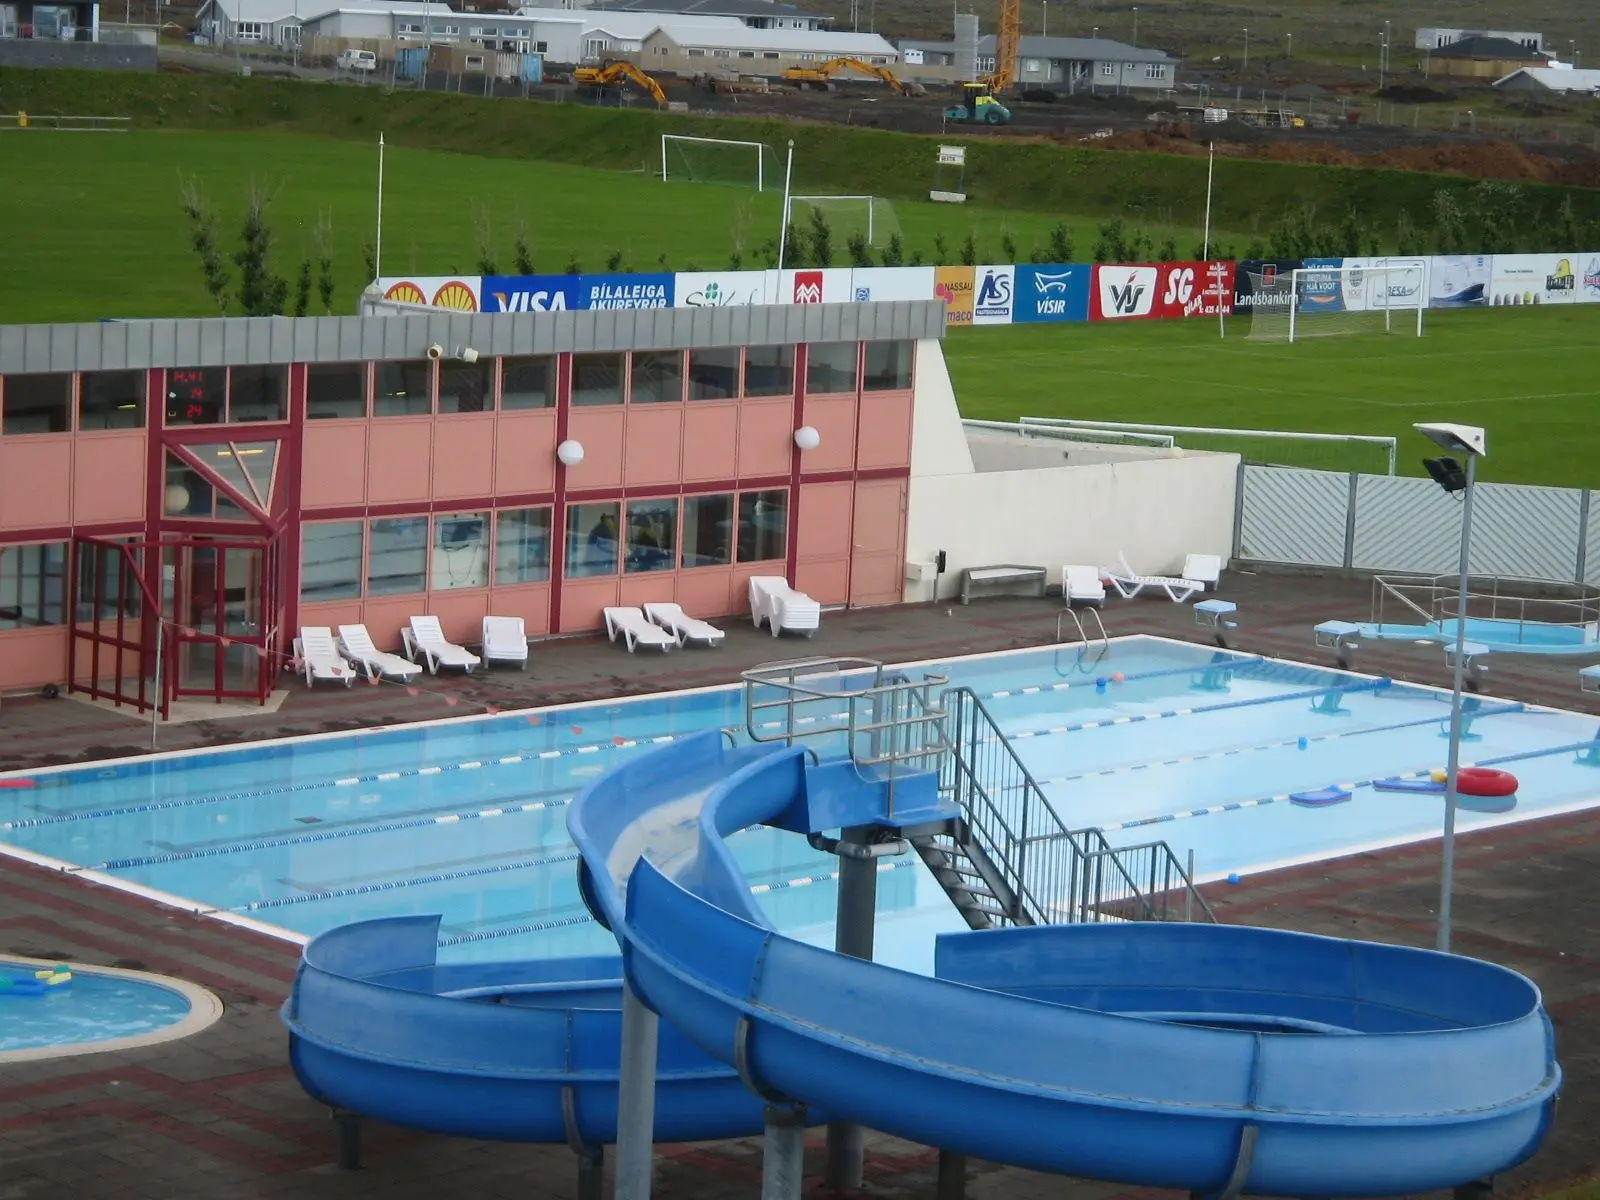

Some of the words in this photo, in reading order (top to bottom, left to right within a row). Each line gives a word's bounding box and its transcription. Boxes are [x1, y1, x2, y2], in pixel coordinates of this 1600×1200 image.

[590, 282, 665, 299] BÍLALEIGA
[944, 282, 973, 291] NASSAU
[976, 270, 1010, 306] ÁS
[1164, 268, 1194, 304] SG
[492, 291, 567, 312] VISA
[589, 298, 667, 310] AKUREYRAR
[1037, 296, 1066, 314] VÍSIR
[187, 404, 203, 417] 24
